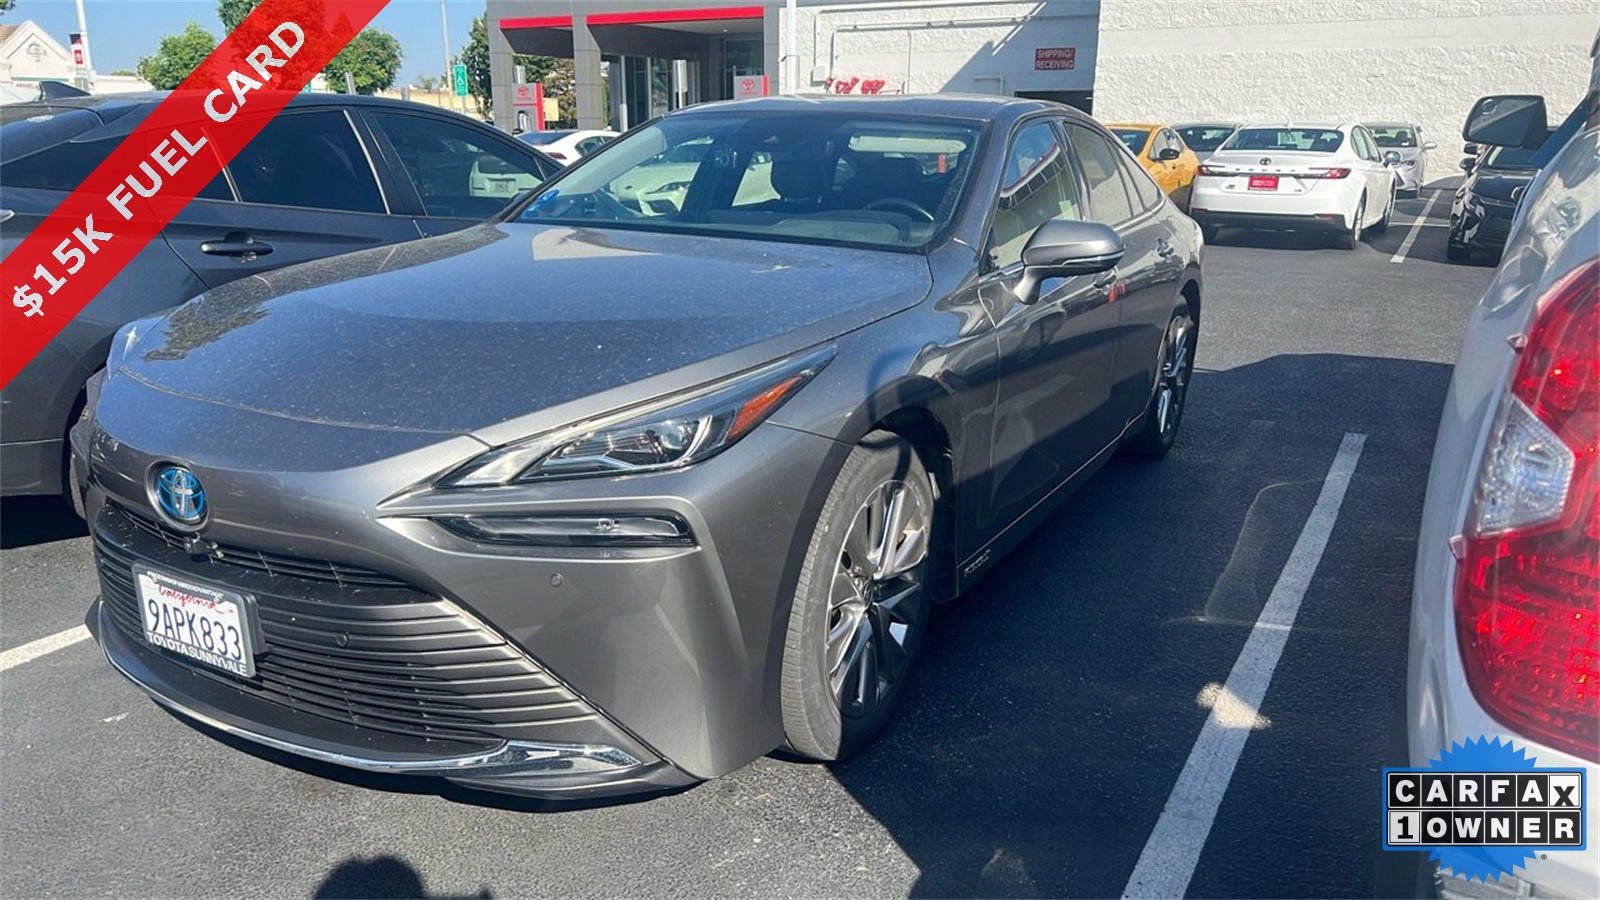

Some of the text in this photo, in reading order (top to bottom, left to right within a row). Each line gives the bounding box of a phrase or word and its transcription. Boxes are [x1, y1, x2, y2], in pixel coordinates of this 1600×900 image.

[1035, 60, 1073, 69] RECEIVING
[148, 598, 242, 661] 9APK833
[147, 632, 247, 674] TOYOTA SUNNYVALE
